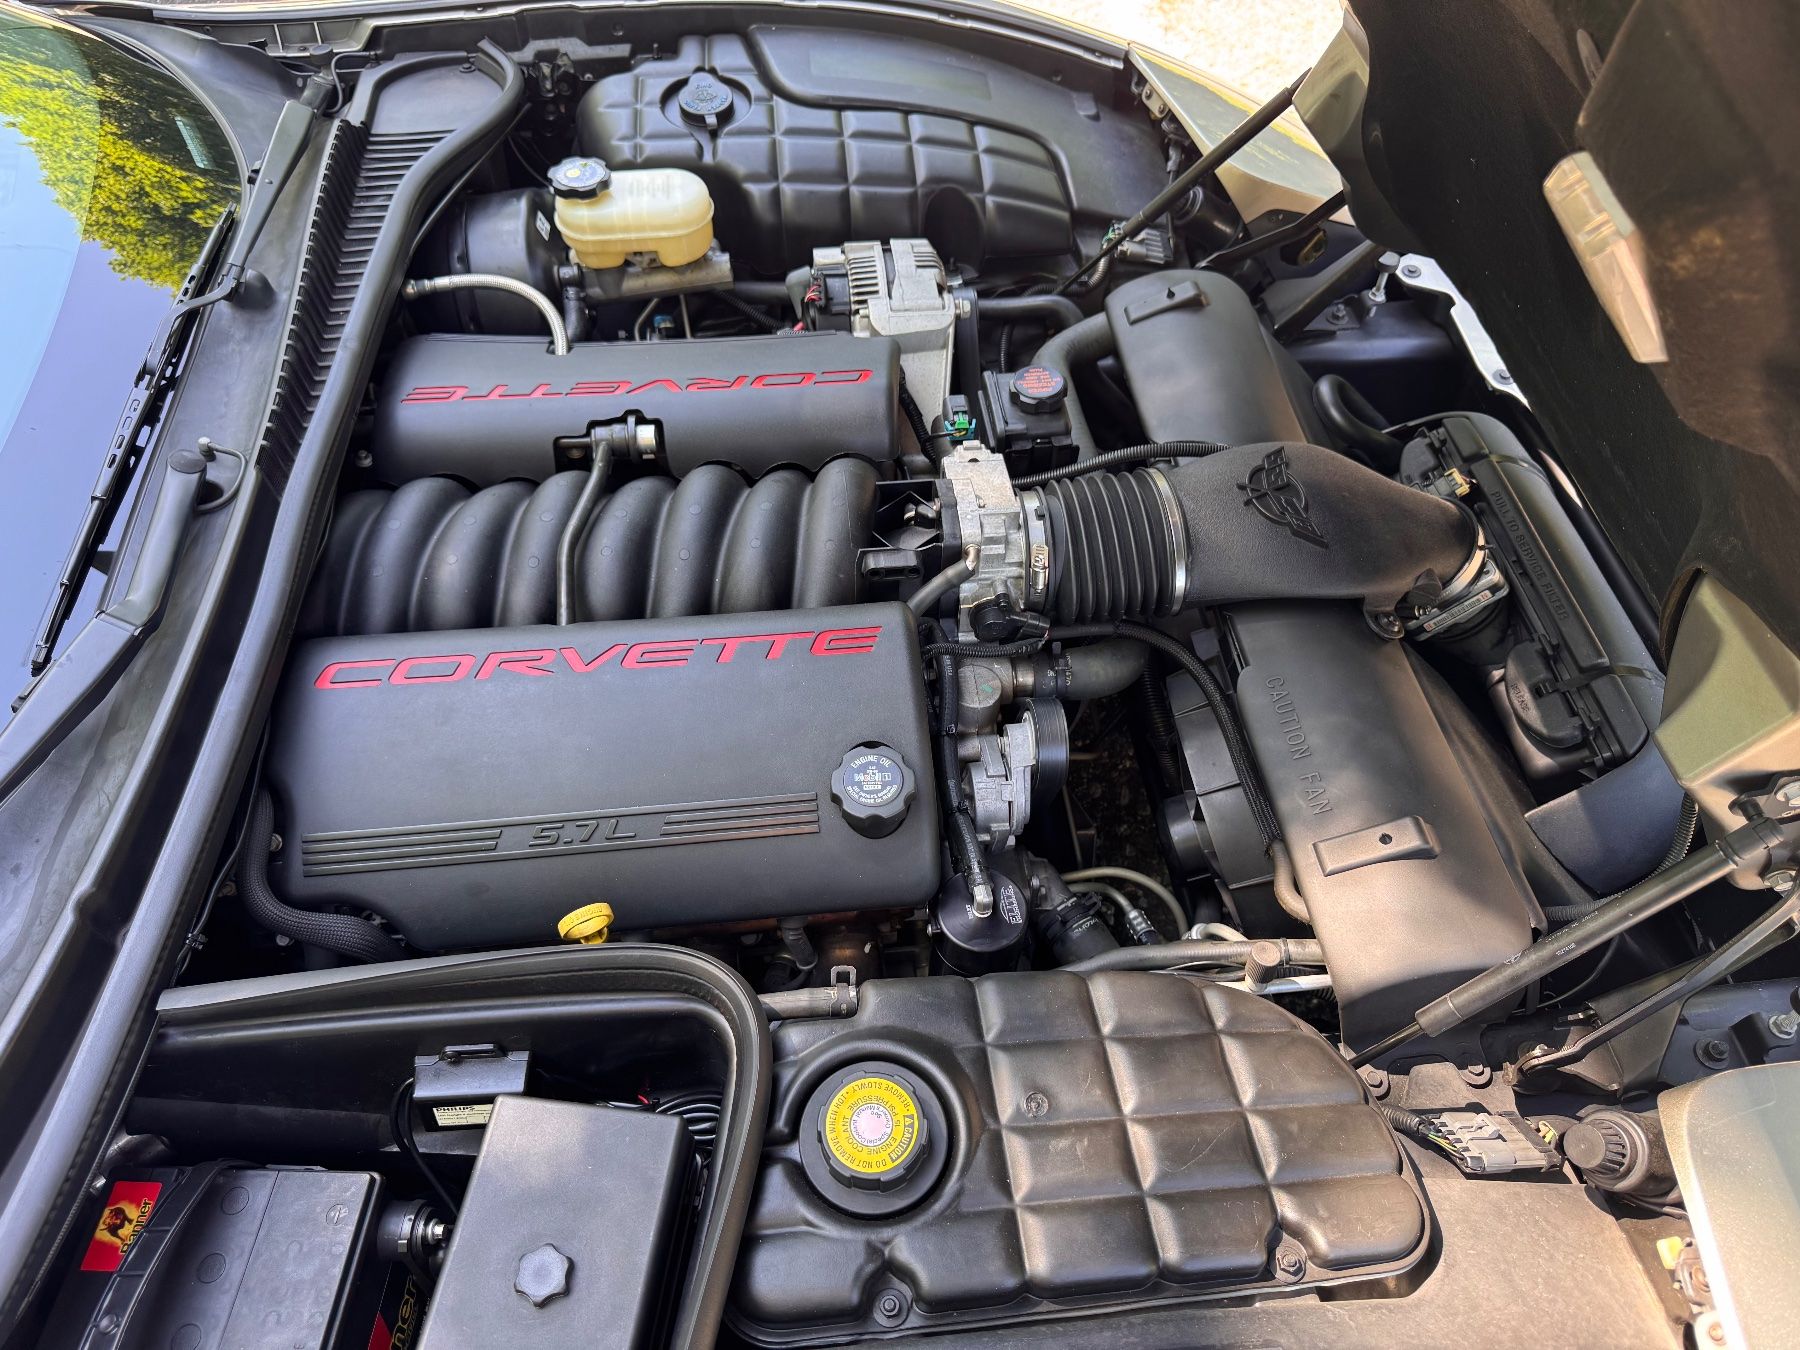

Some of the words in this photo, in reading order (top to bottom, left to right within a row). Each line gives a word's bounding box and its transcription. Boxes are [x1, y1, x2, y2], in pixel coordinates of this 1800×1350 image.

[401, 369, 874, 403] CORVETTE
[1490, 491, 1509, 518] PULL
[1507, 519, 1519, 532] TO
[1515, 534, 1547, 581] SERVICE
[1541, 582, 1568, 620] FILTER
[314, 626, 882, 689] CORVETTE
[1266, 676, 1311, 760] CAUTION
[1300, 771, 1332, 815] FAN
[851, 755, 878, 768] ENGINE
[880, 757, 892, 768] OIL
[529, 819, 637, 847] 5.7L
[852, 1082, 883, 1092] SLOWLY
[884, 1083, 909, 1110] REMOVE
[835, 1094, 847, 1111] HOT
[847, 1095, 889, 1111] PRESSURE
[889, 1103, 897, 1117] PSI
[828, 1112, 838, 1134] WHEN
[842, 1115, 864, 1152] COOLANT
[894, 1119, 901, 1127] 15
[830, 1136, 857, 1164] REMOVE
[866, 1137, 897, 1155] ENGINE
[890, 1128, 913, 1161] CAUTION
[856, 1159, 873, 1169] NOT
[876, 1158, 887, 1169] DO
